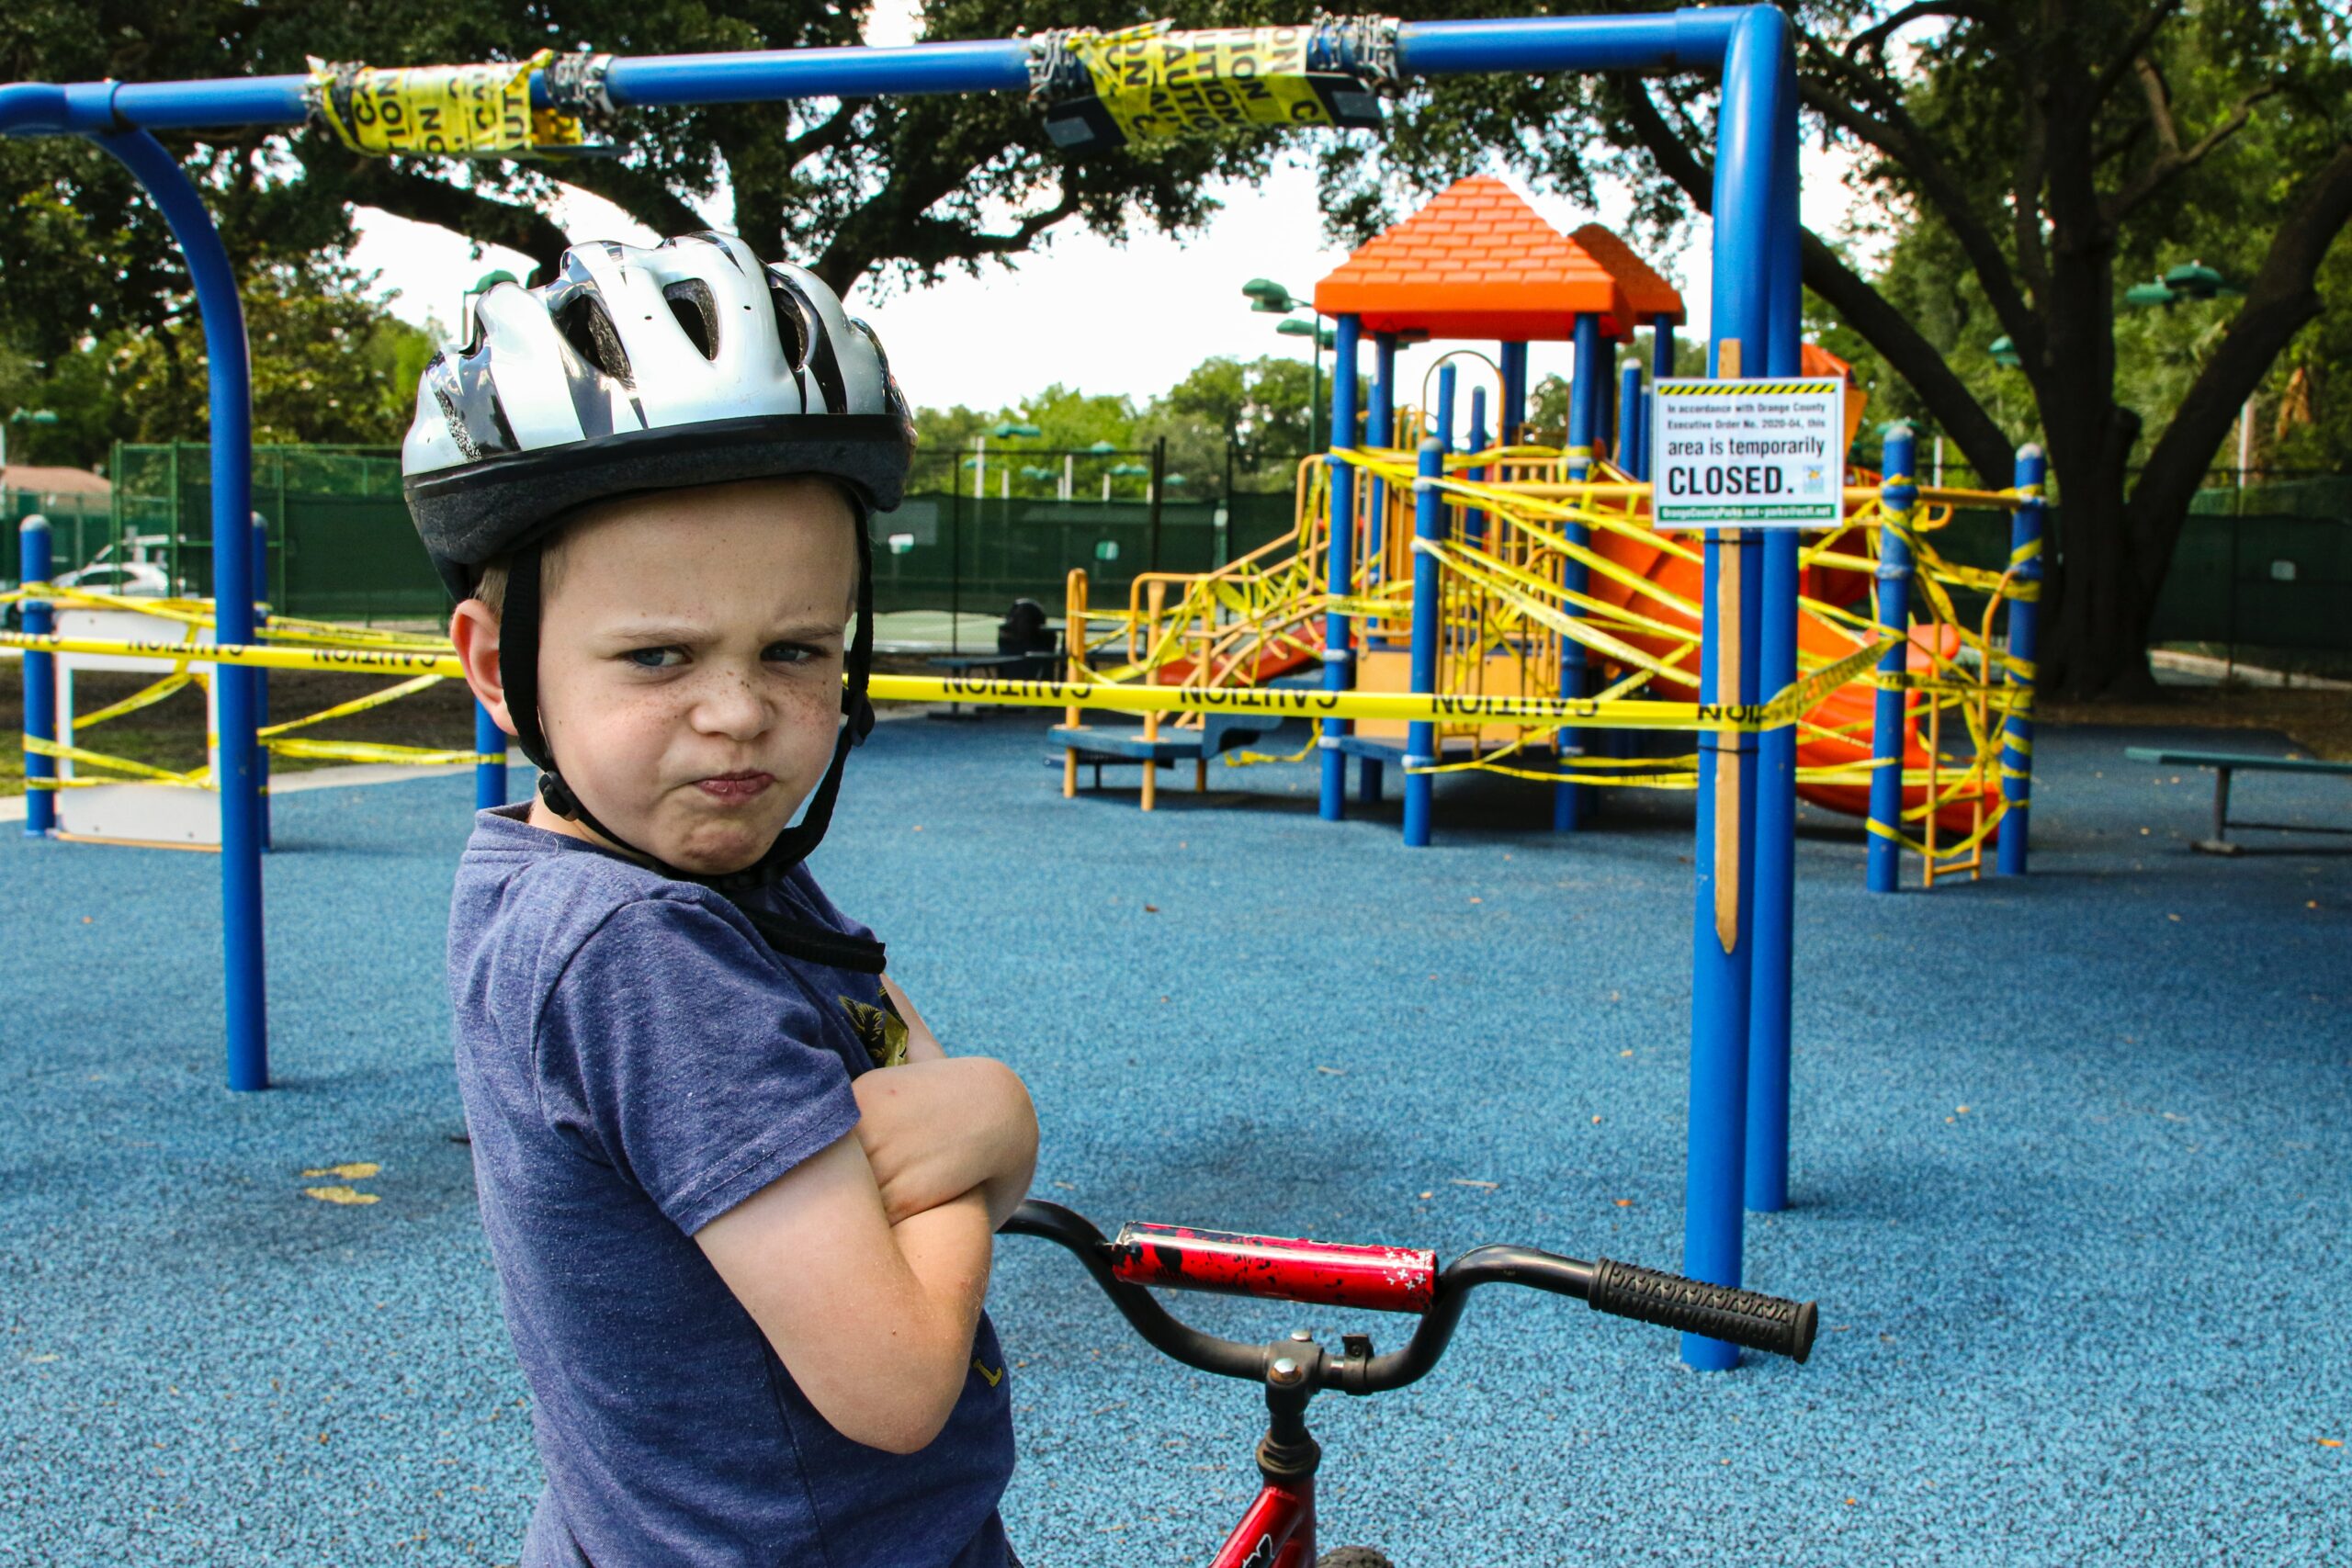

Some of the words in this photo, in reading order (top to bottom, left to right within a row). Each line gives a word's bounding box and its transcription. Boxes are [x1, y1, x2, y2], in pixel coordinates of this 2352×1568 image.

[1679, 403, 1731, 413] accordance
[1736, 402, 1755, 412] with
[1758, 402, 1790, 414] Orange
[1793, 401, 1826, 413] County
[1668, 420, 1712, 430] Executive
[1714, 420, 1740, 430] Order
[1807, 418, 1826, 428] this
[1668, 441, 1703, 456] area
[1710, 437, 1724, 456] is
[1729, 436, 1826, 458] temporarily
[1668, 466, 1794, 496] CLOSED.
